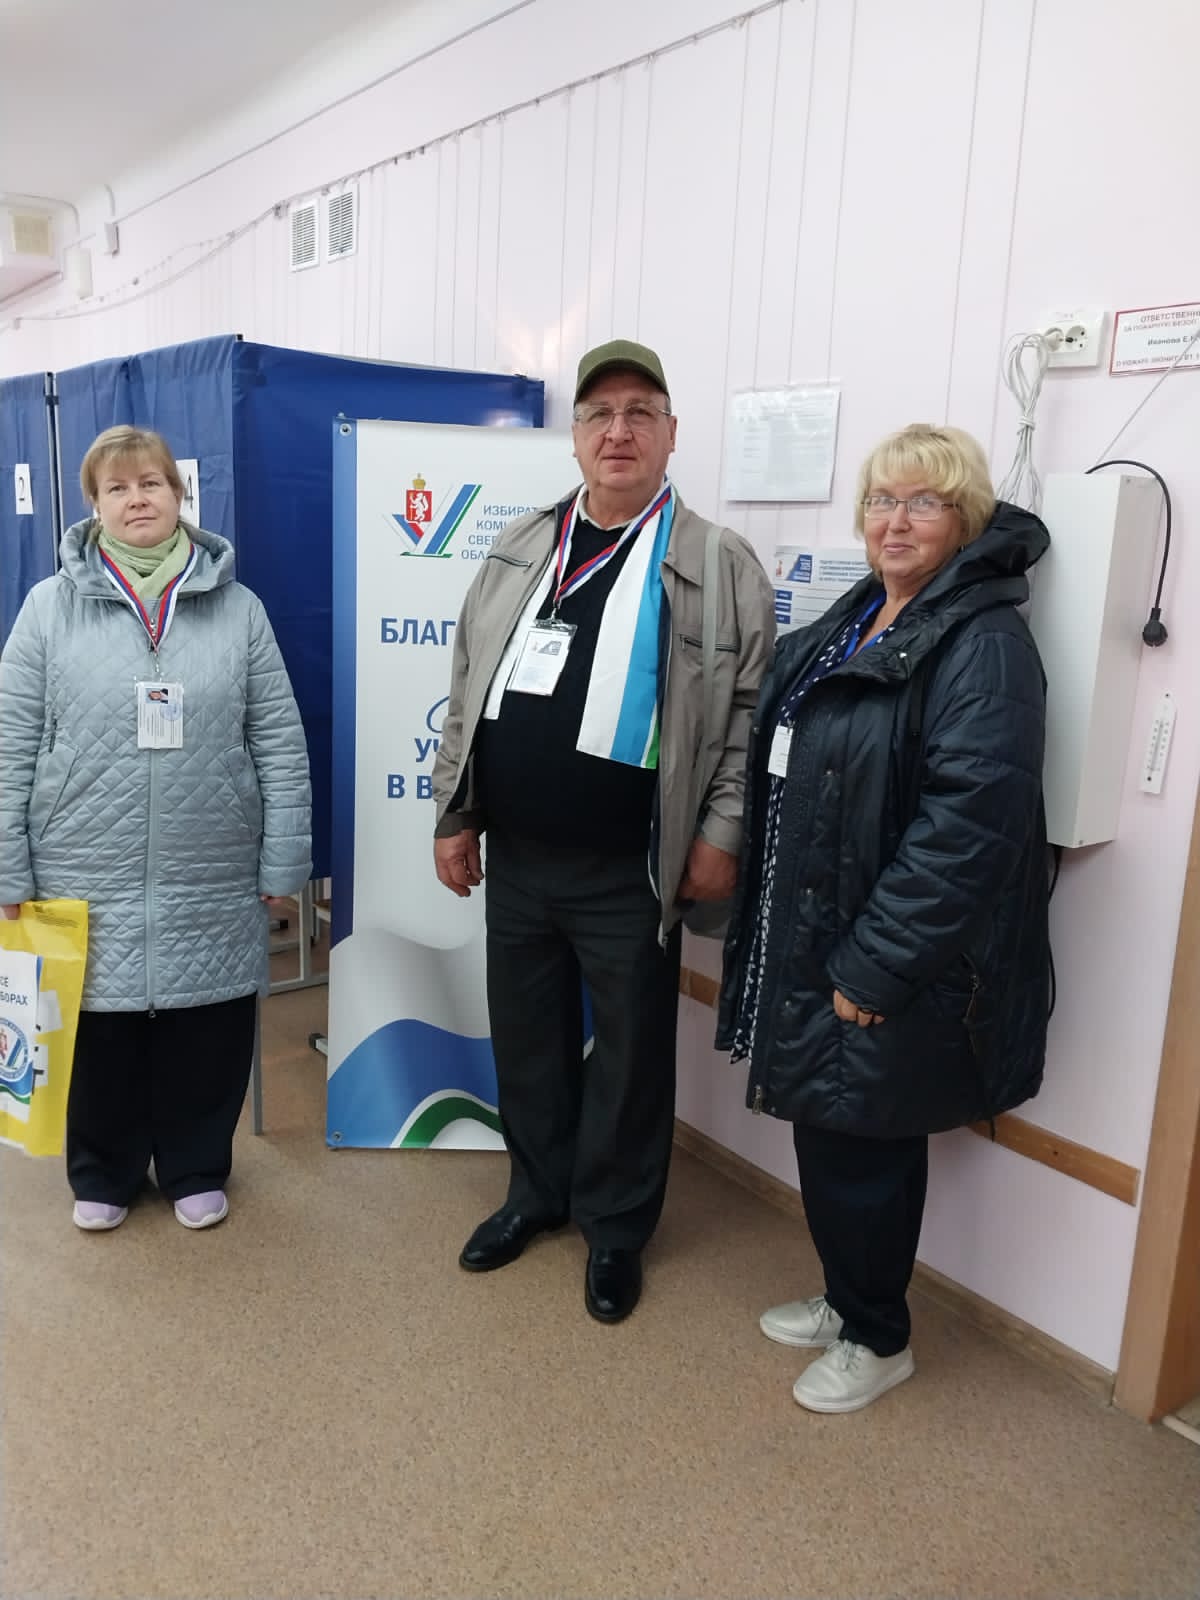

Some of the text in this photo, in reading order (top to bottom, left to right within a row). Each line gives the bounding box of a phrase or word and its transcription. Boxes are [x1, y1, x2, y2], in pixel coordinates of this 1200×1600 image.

[18, 476, 26, 502] 2
[183, 474, 194, 511] 4
[380, 617, 457, 647] БЛАГ
[387, 773, 406, 799] В
